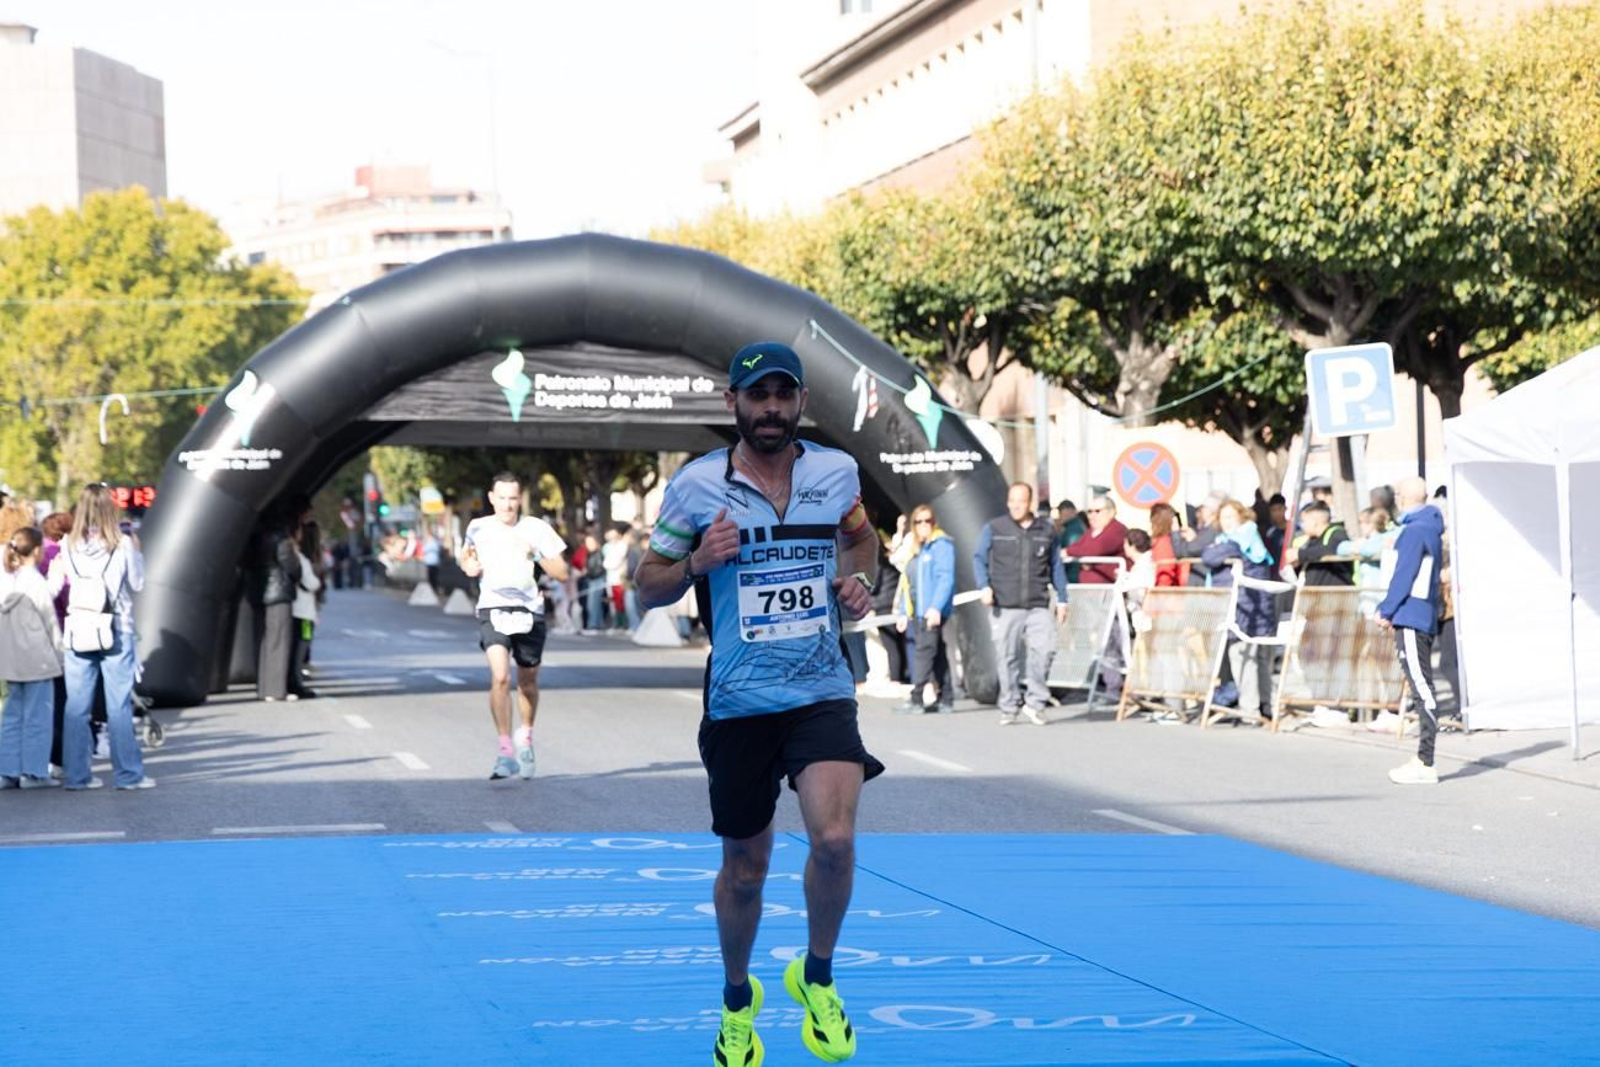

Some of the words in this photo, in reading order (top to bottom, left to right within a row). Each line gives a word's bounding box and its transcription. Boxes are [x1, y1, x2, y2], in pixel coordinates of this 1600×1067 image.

[534, 373, 612, 391] Patronato
[613, 374, 690, 395] Municipal
[692, 376, 714, 393] de
[1324, 356, 1378, 427] P
[534, 391, 608, 410] Deportes
[609, 392, 632, 409] de
[757, 585, 815, 614] 798
